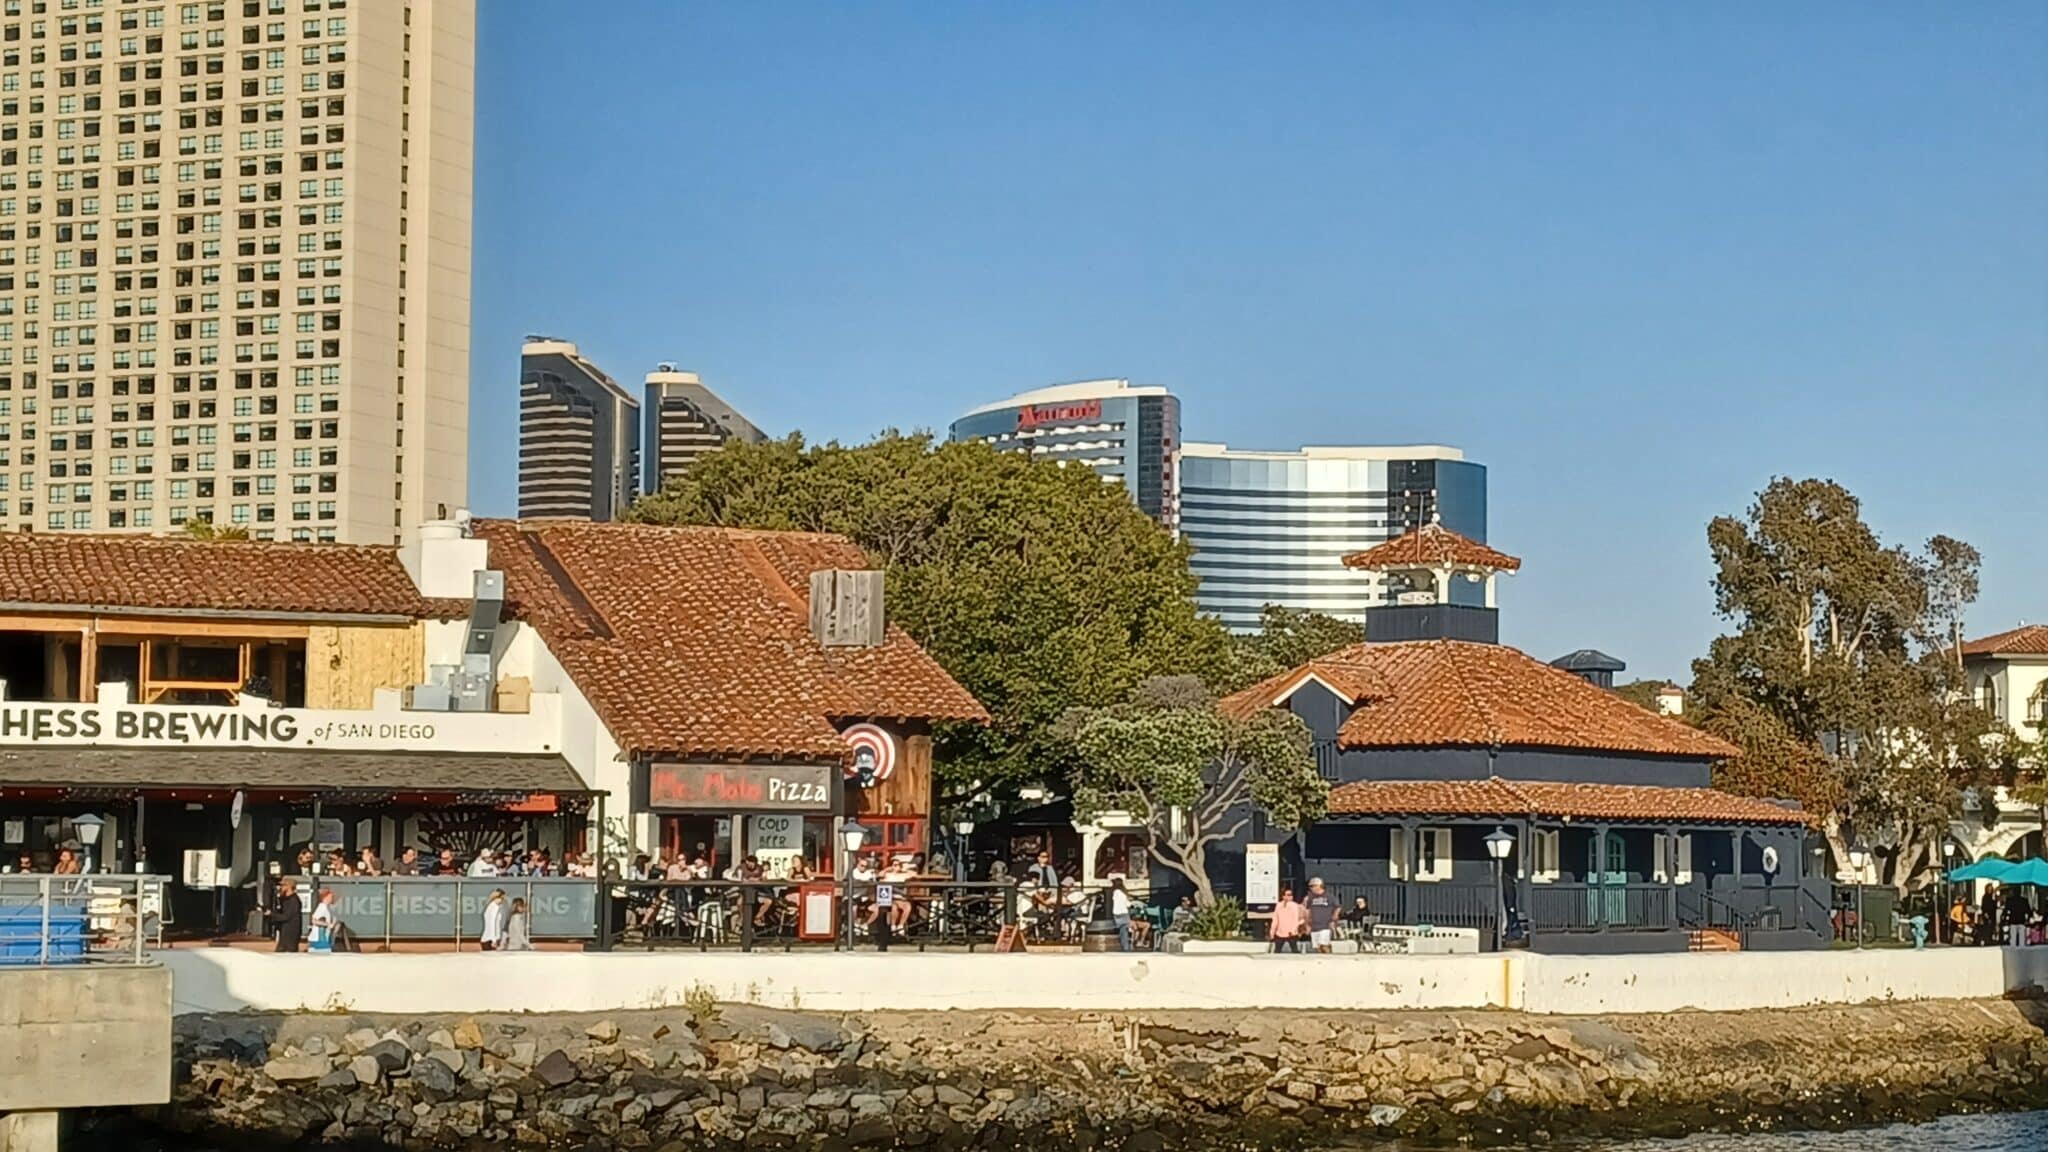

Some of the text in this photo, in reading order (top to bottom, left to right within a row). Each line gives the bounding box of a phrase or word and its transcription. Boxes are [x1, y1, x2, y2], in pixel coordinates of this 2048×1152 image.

[2, 708, 435, 742] HESS BREWING of SAN DIEGO
[768, 777, 828, 802] Pizza
[758, 817, 790, 832] COLD
[393, 896, 450, 915] HESS
